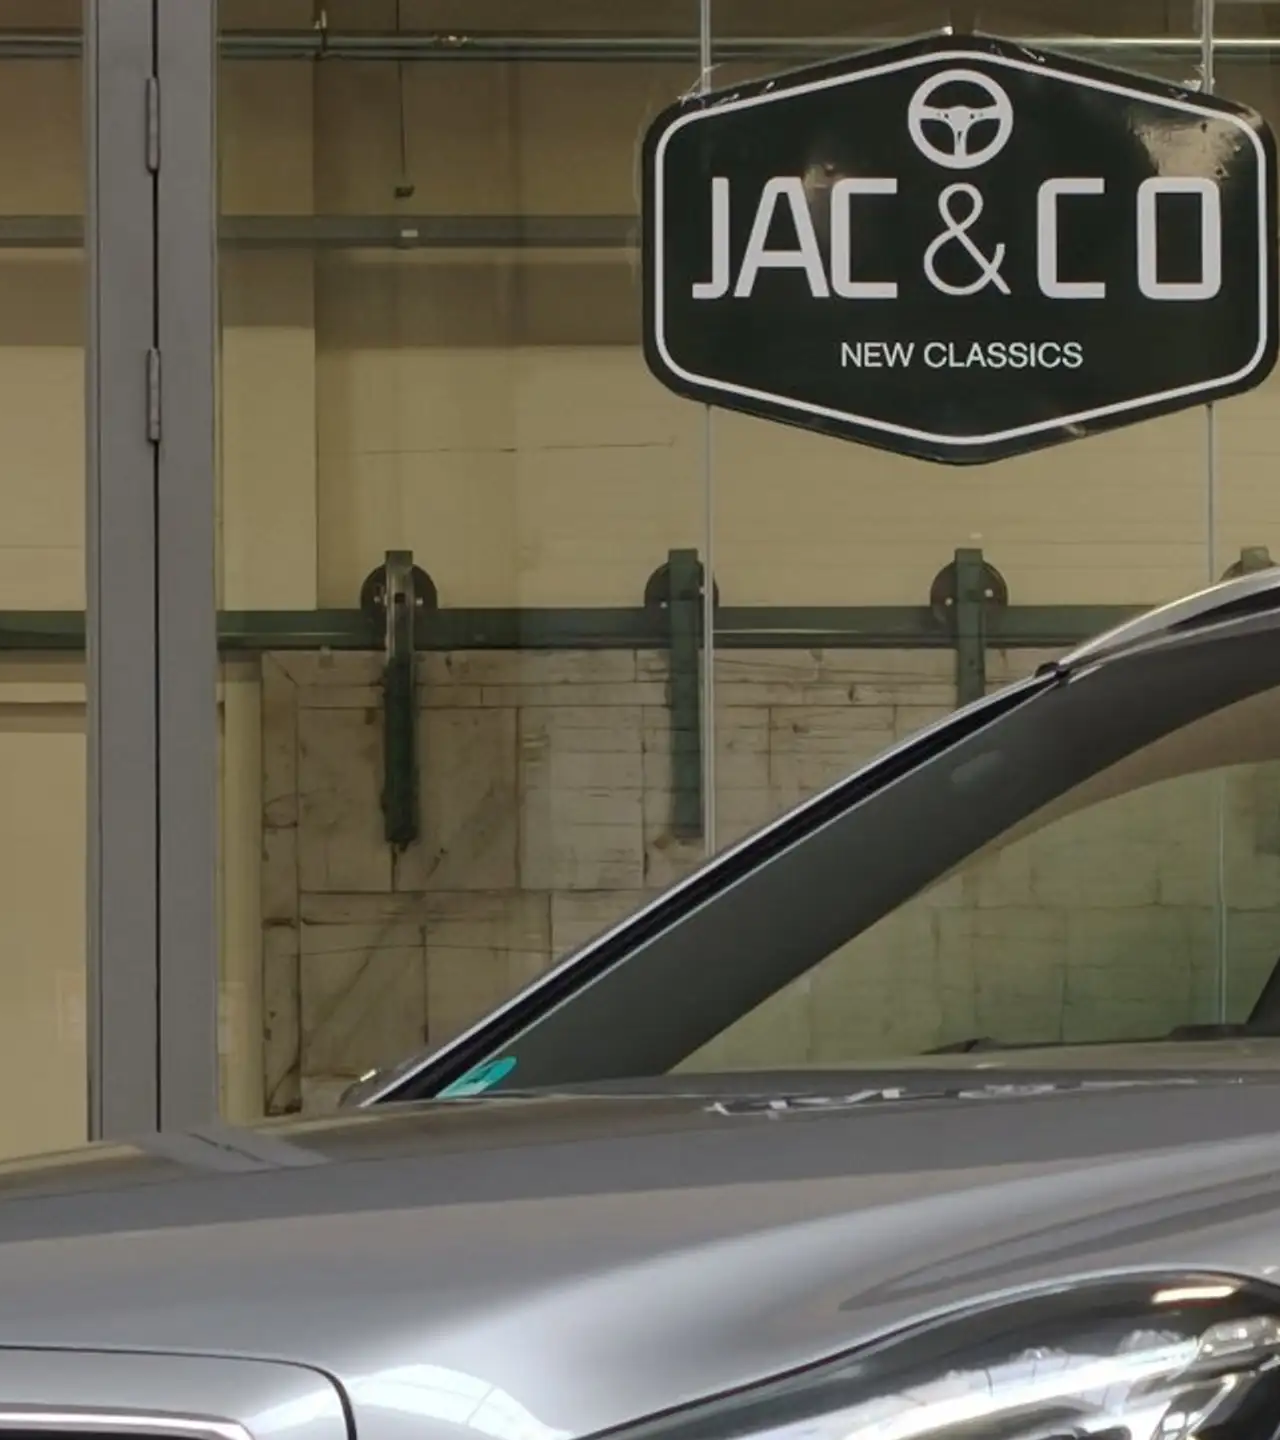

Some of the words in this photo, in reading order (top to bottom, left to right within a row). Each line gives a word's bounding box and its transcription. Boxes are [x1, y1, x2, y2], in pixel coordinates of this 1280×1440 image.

[692, 175, 898, 299] JAC
[923, 183, 1011, 296] &
[1037, 175, 1222, 300] CO
[840, 341, 915, 369] NEW
[923, 341, 1084, 369] CLASSICS
